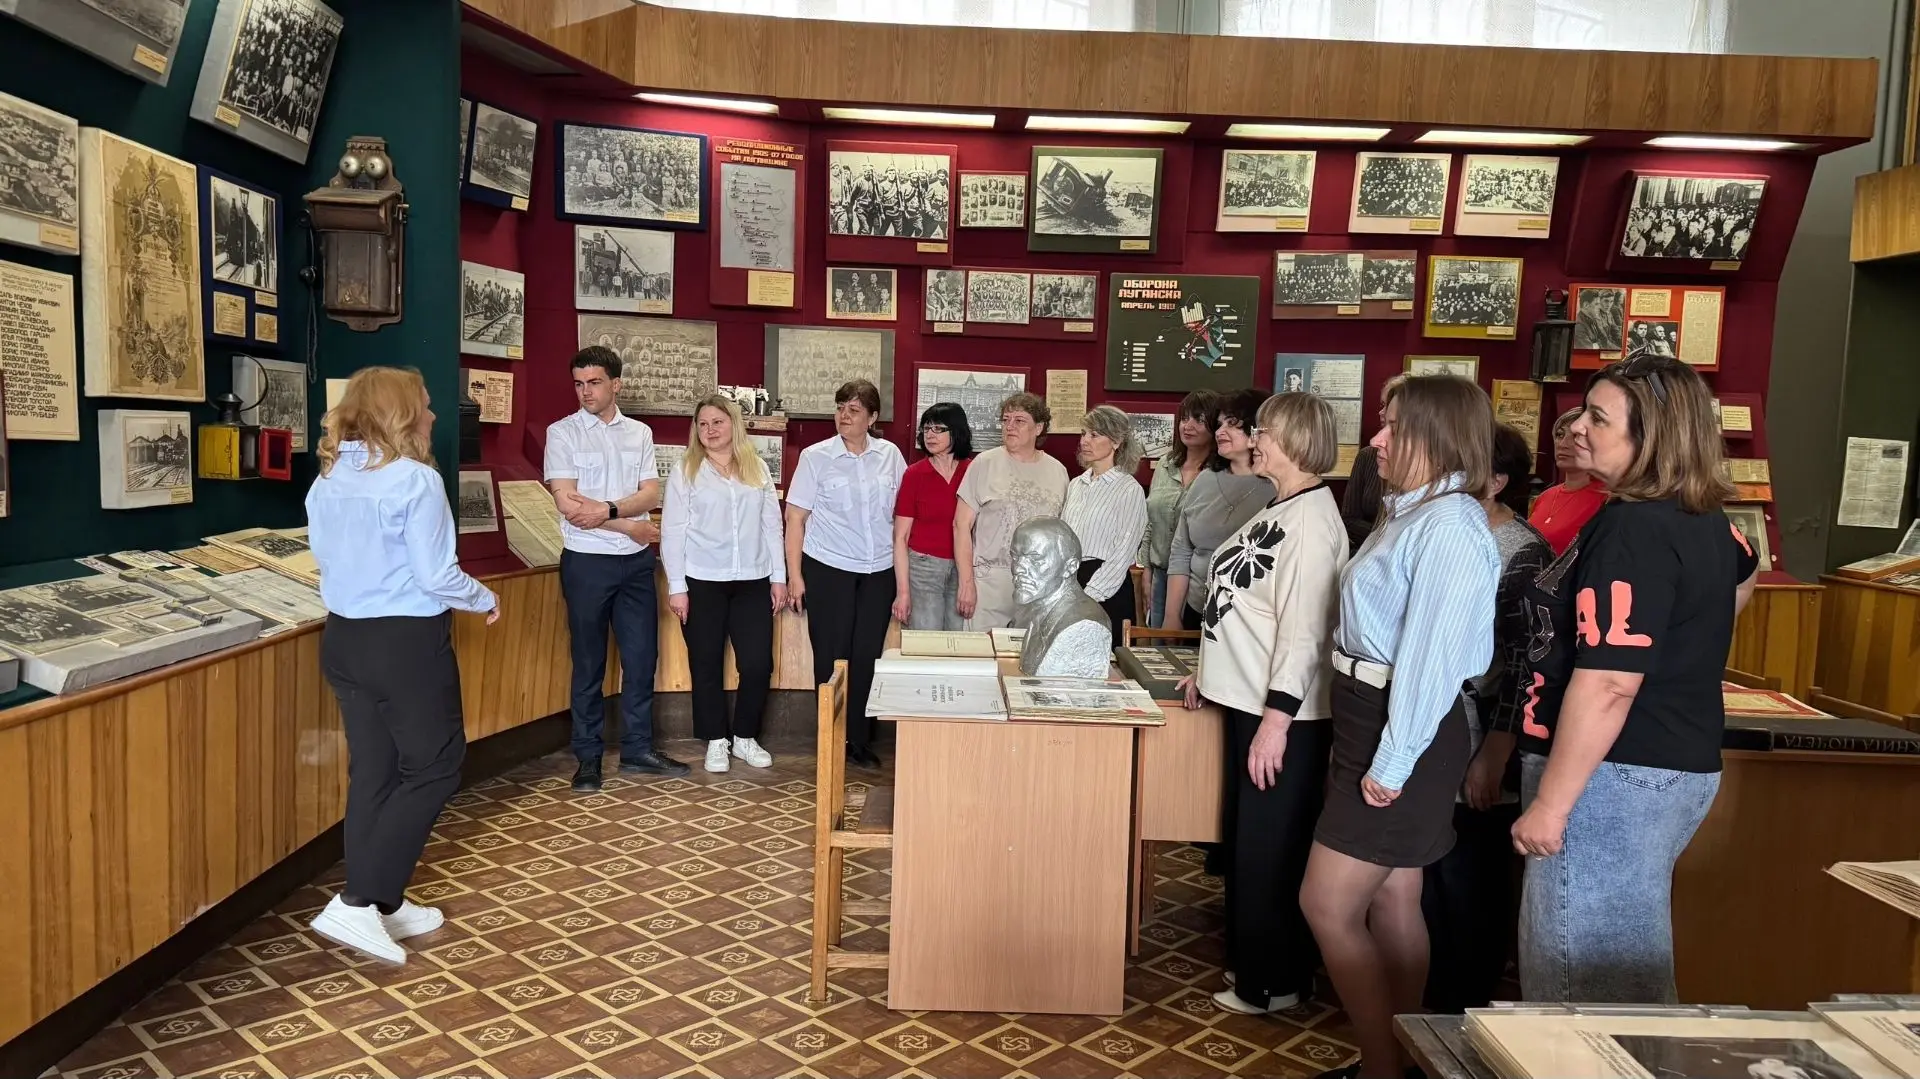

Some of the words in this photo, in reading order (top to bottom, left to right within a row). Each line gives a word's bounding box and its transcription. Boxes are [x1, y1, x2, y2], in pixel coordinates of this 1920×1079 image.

[715, 145, 750, 155] СОБЫТИЯ
[781, 152, 804, 161] ГОДОВ
[743, 156, 788, 167] ЛУГАНЩИНЕ
[1123, 280, 1178, 289] ОБОРОНА
[1118, 289, 1182, 299] ЛУГАНСКА
[2, 347, 18, 355] БОРИС
[1784, 734, 1855, 750] ПОЧЕТА
[1863, 738, 1920, 753] КНИГА
